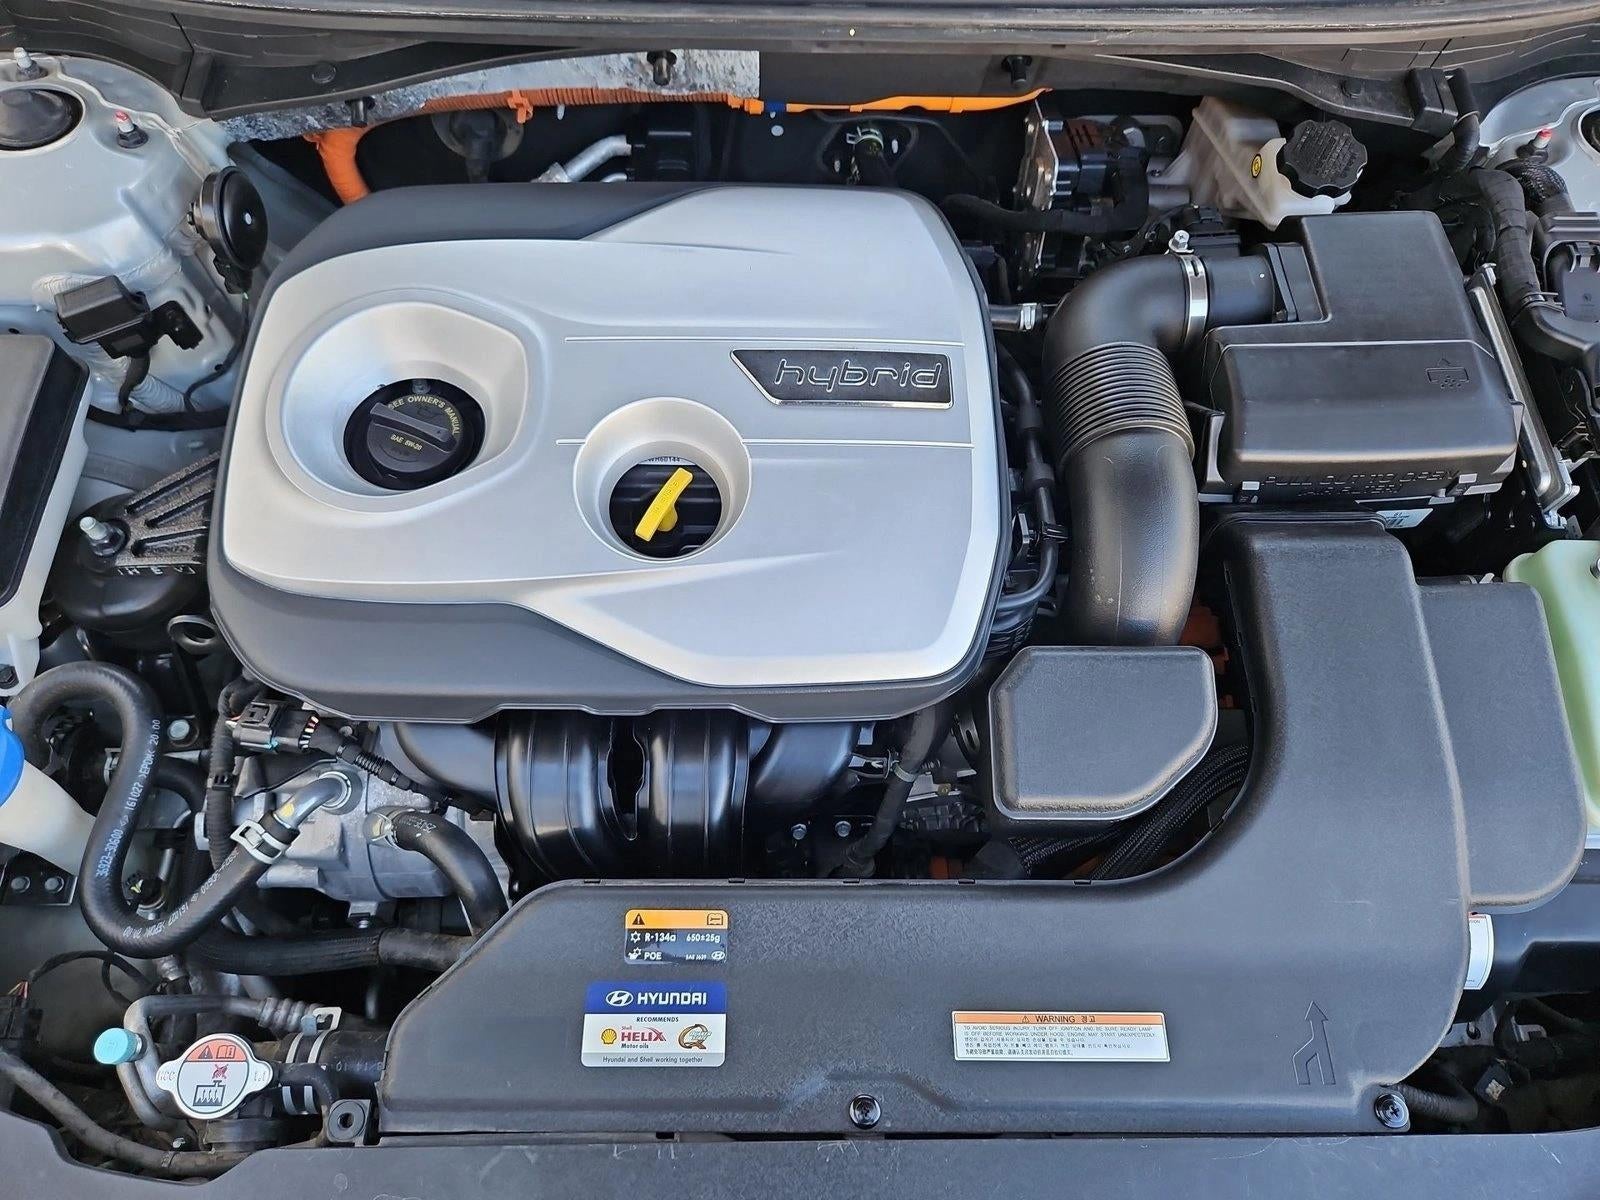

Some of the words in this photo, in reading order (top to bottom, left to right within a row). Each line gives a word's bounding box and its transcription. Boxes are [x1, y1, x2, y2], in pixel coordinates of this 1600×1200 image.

[774, 358, 942, 392] hybrid
[388, 398, 405, 409] SEE
[407, 396, 446, 409] OWNER'S
[644, 952, 662, 960] POE
[637, 992, 707, 1005] HYUNDAI
[1034, 1015, 1076, 1023] WARNING
[621, 1030, 667, 1042] HELIX
[655, 1056, 678, 1064] working
[679, 1056, 703, 1064] together
